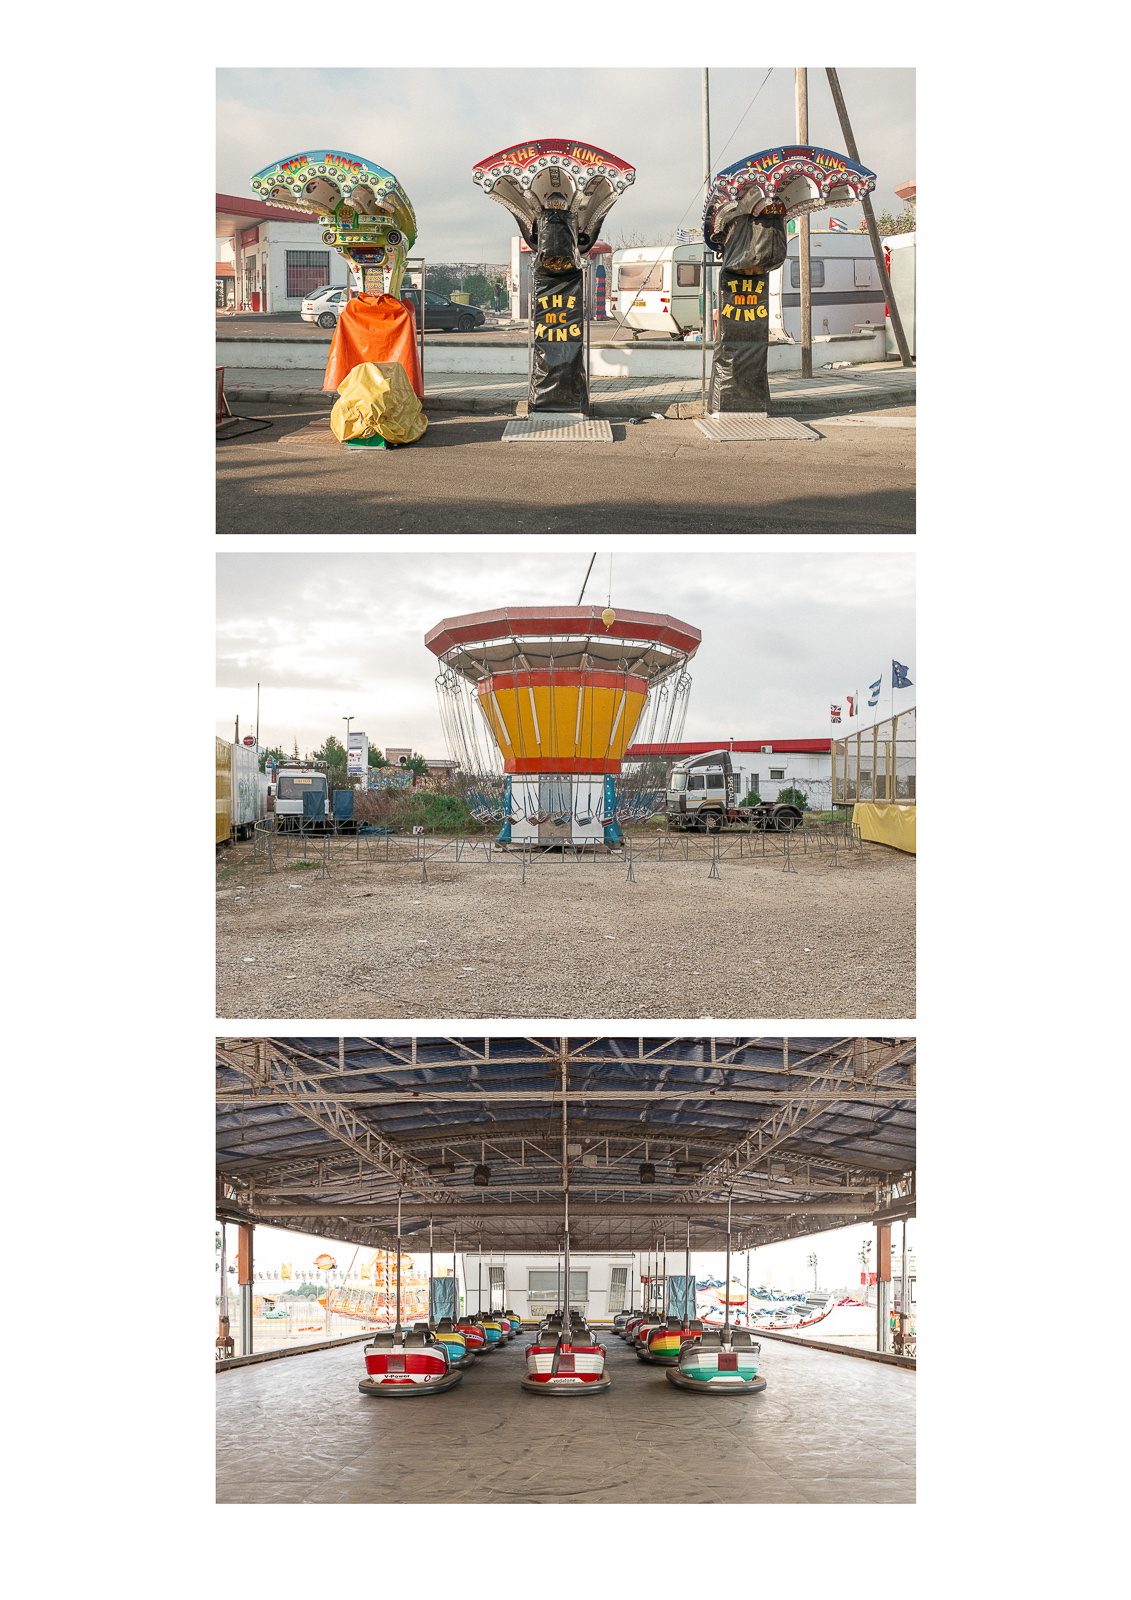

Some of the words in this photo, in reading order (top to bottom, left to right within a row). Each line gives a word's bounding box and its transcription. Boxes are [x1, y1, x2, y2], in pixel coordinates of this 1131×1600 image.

[281, 155, 308, 175] THE
[324, 153, 362, 175] KING
[508, 146, 536, 165] THE
[572, 146, 604, 166] KING
[752, 152, 780, 172] THE
[815, 153, 847, 172] KING
[727, 279, 765, 294] THE
[537, 294, 576, 309] THE
[721, 303, 768, 322] KING
[535, 323, 581, 342] KING
[725, 1357, 732, 1368] 9
